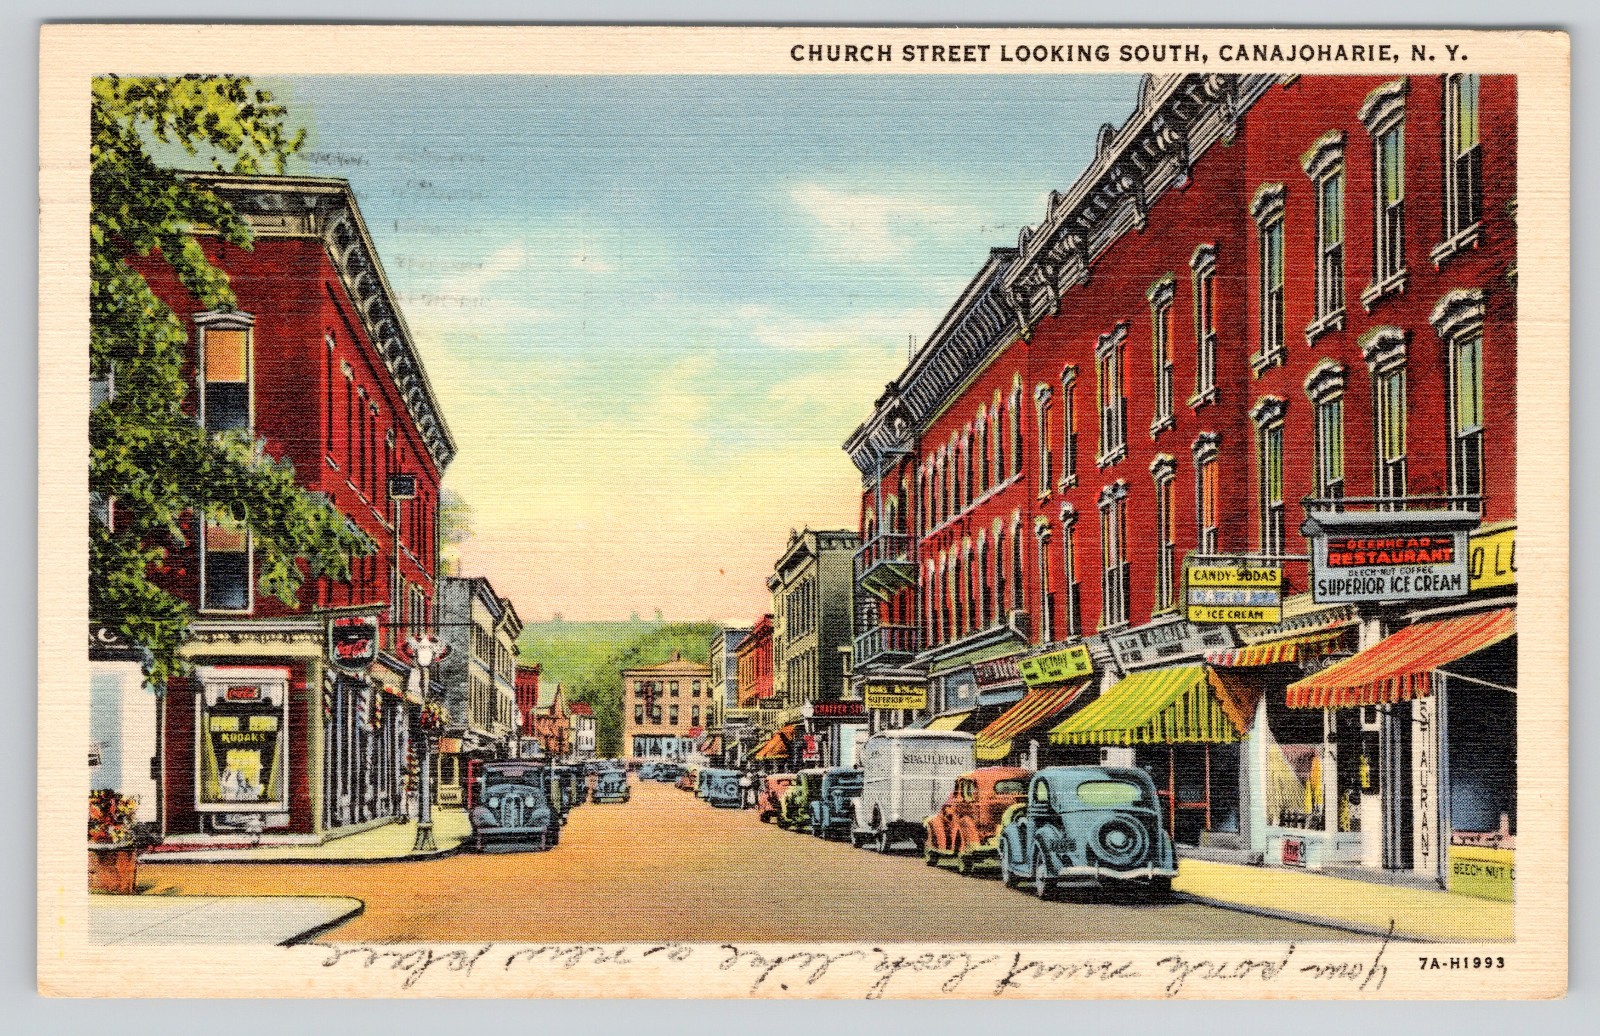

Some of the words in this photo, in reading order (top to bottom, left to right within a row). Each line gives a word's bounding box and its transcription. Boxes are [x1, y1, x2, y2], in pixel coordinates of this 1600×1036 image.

[1347, 537, 1431, 549] DEERHEAD
[1328, 548, 1452, 566] RESTAURANT
[1400, 565, 1434, 575] COFFEE
[1318, 576, 1385, 597] SUPERIOR
[1390, 576, 1410, 593] ICE
[1414, 574, 1462, 592] CREAM
[1207, 610, 1224, 620] ICE
[1227, 610, 1264, 620] CREAM
[221, 733, 265, 743] KODAKS
[1419, 700, 1430, 869] STAURANT
[1453, 862, 1483, 876] BEECH
[1485, 866, 1504, 879] NUT
[643, 943, 692, 962] a
[720, 944, 864, 994] like
